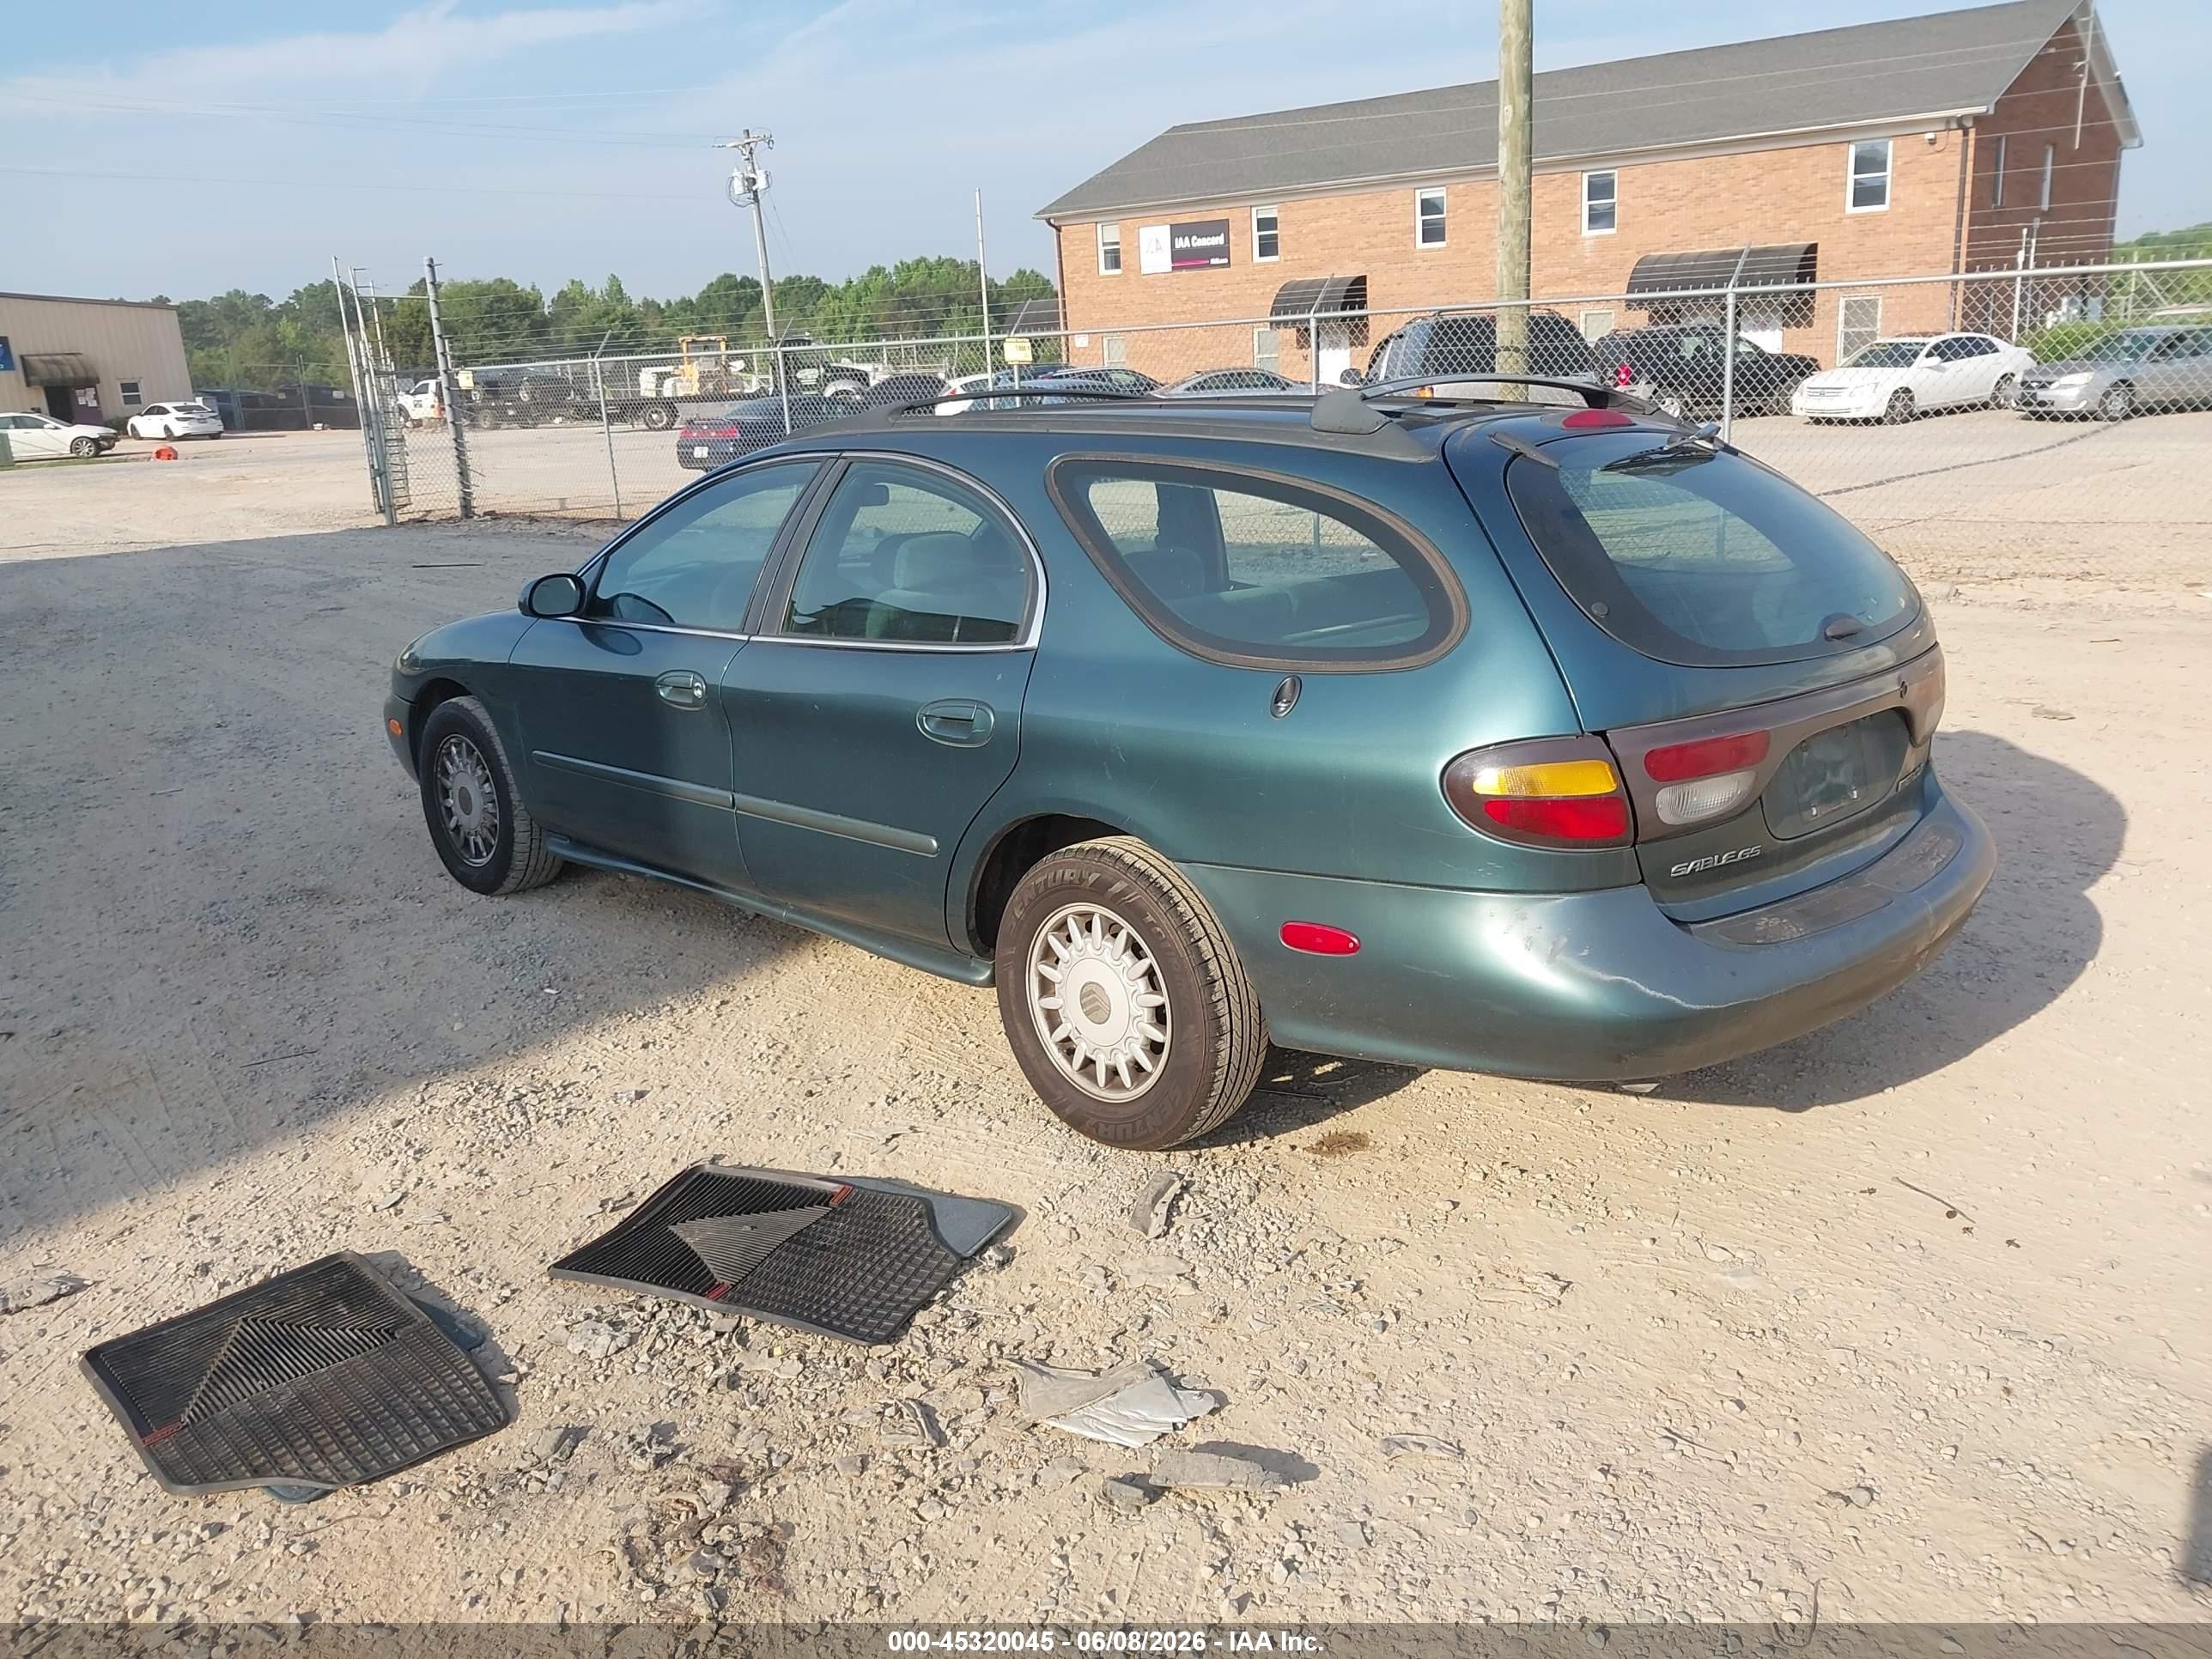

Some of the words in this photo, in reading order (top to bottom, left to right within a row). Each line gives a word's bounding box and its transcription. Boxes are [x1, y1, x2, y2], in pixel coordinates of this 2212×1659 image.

[1175, 236, 1191, 249] IAA
[1191, 233, 1224, 247] Concord
[1670, 850, 1737, 878] SABLE
[1737, 845, 1761, 860] GS
